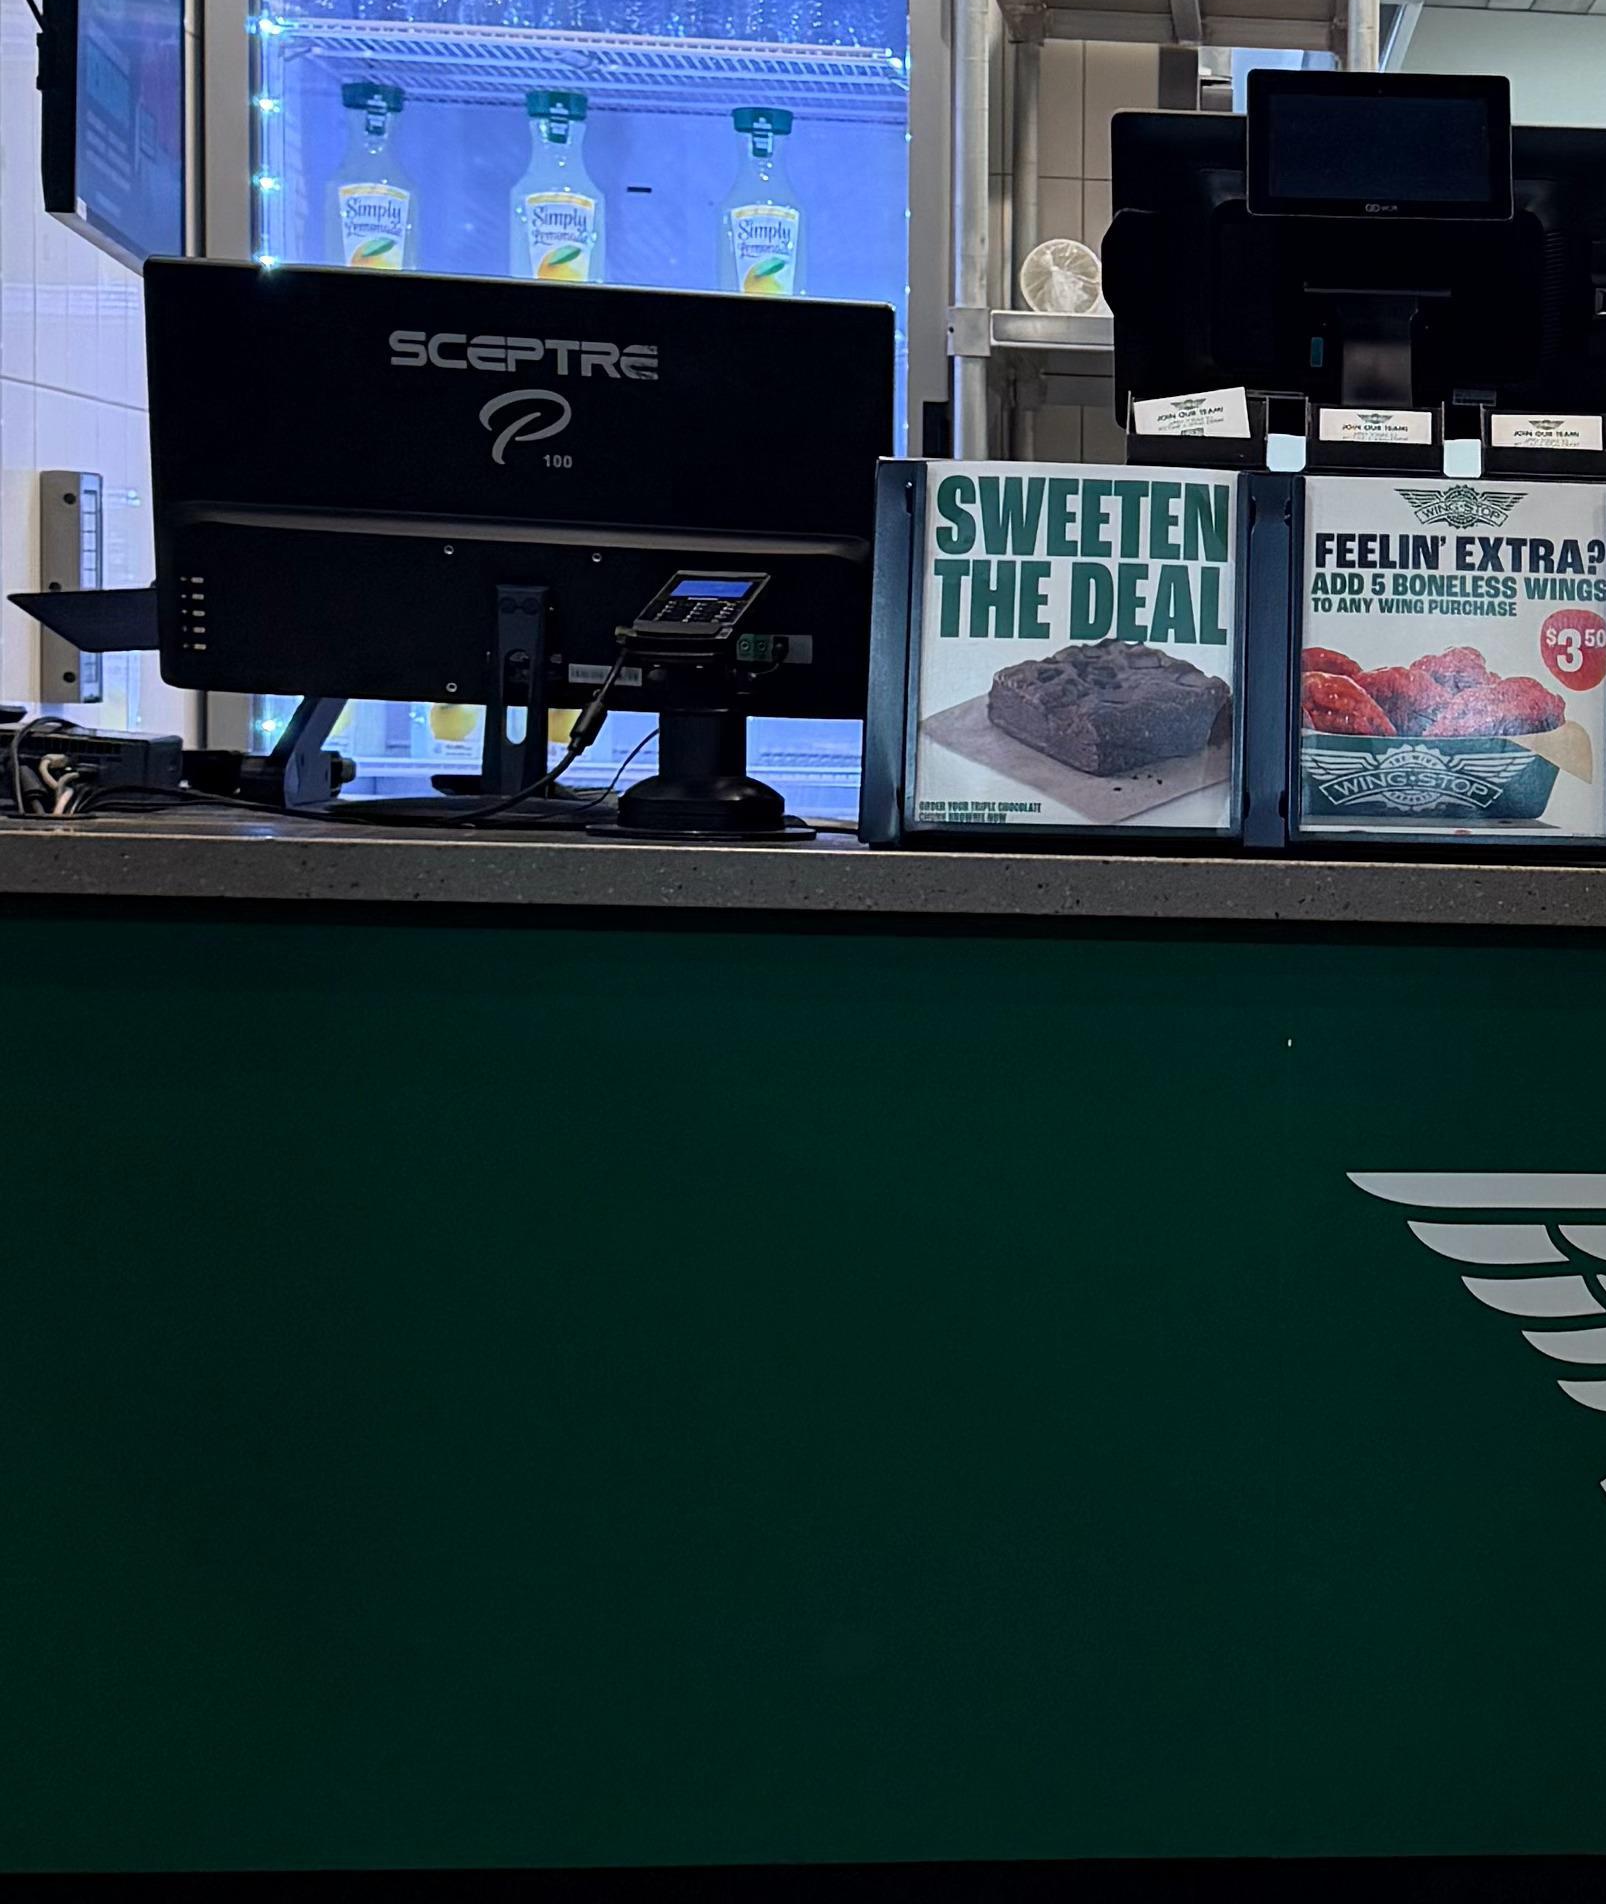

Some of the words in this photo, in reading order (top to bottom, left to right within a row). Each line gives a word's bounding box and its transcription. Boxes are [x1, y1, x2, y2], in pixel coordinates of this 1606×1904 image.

[345, 198, 402, 226] Simply
[532, 206, 588, 233] Simply
[737, 220, 792, 247] Simply
[388, 329, 659, 381] SCEPTRE
[543, 454, 573, 469] 100
[935, 474, 1230, 563] SWEETEN
[1455, 537, 1606, 575] EXTRA?
[1311, 572, 1365, 595] ADD
[1371, 574, 1384, 596] 5
[1391, 574, 1518, 599] BONELESS
[934, 559, 1052, 639] THE
[1069, 561, 1228, 646] DEAL
[1312, 597, 1331, 613] TO
[1336, 598, 1372, 614] ANY
[1378, 599, 1424, 615] WING
[1428, 600, 1517, 617] PURCHASE
